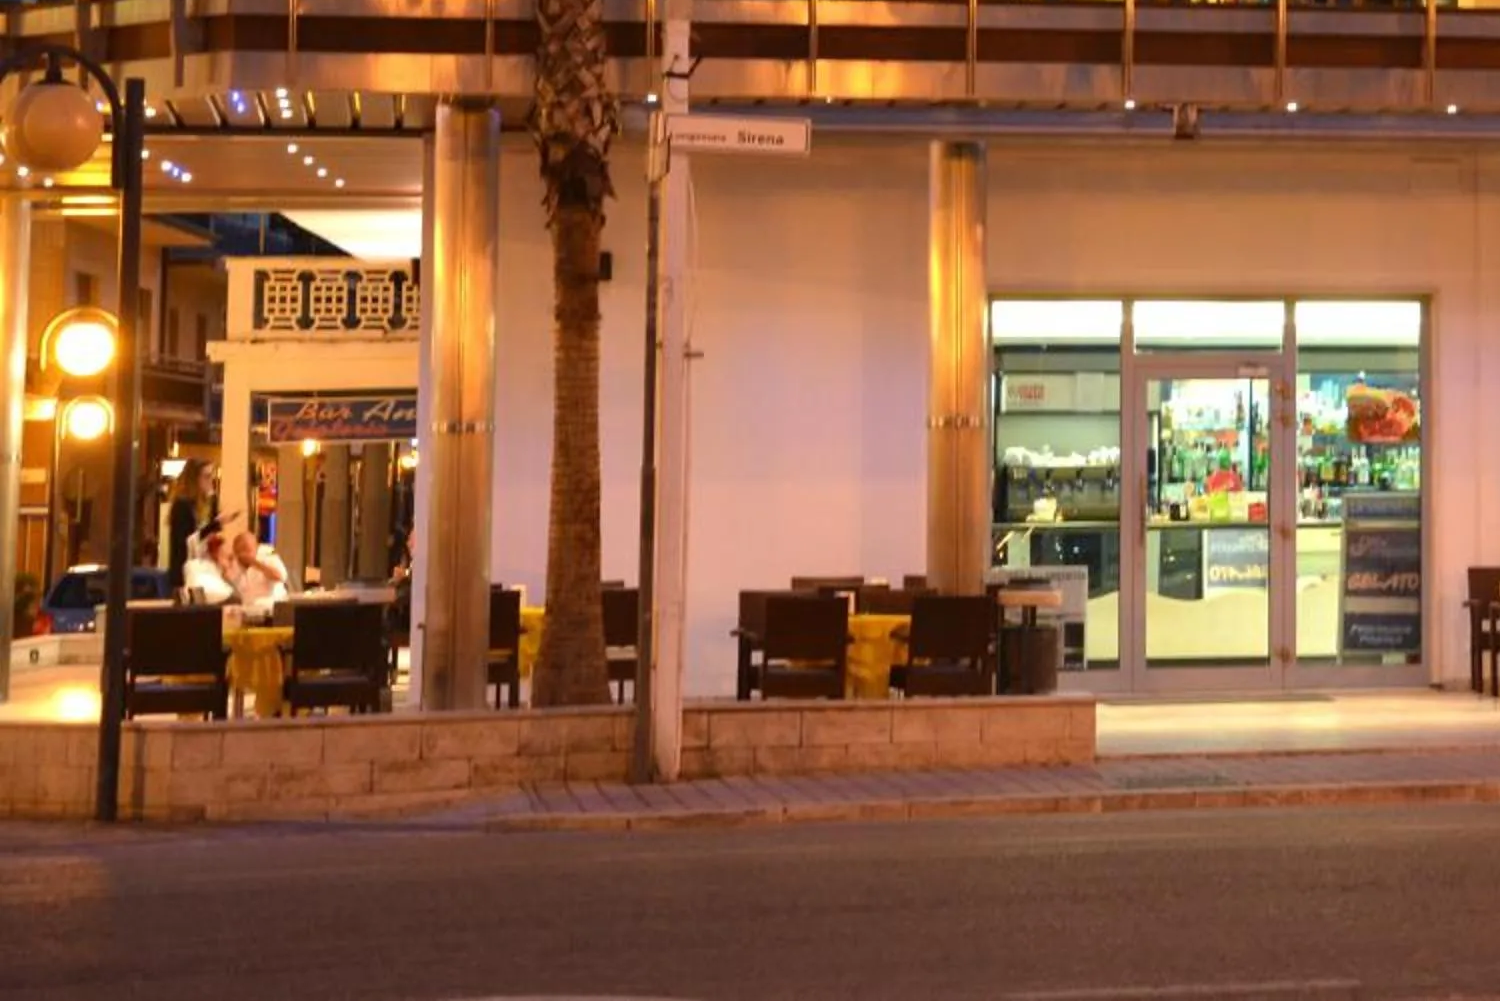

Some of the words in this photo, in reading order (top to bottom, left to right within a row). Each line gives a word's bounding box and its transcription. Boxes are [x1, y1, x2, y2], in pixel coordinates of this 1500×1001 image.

[738, 130, 785, 146] Sirena
[295, 399, 352, 420] Bar
[1347, 572, 1420, 592] GELATO
